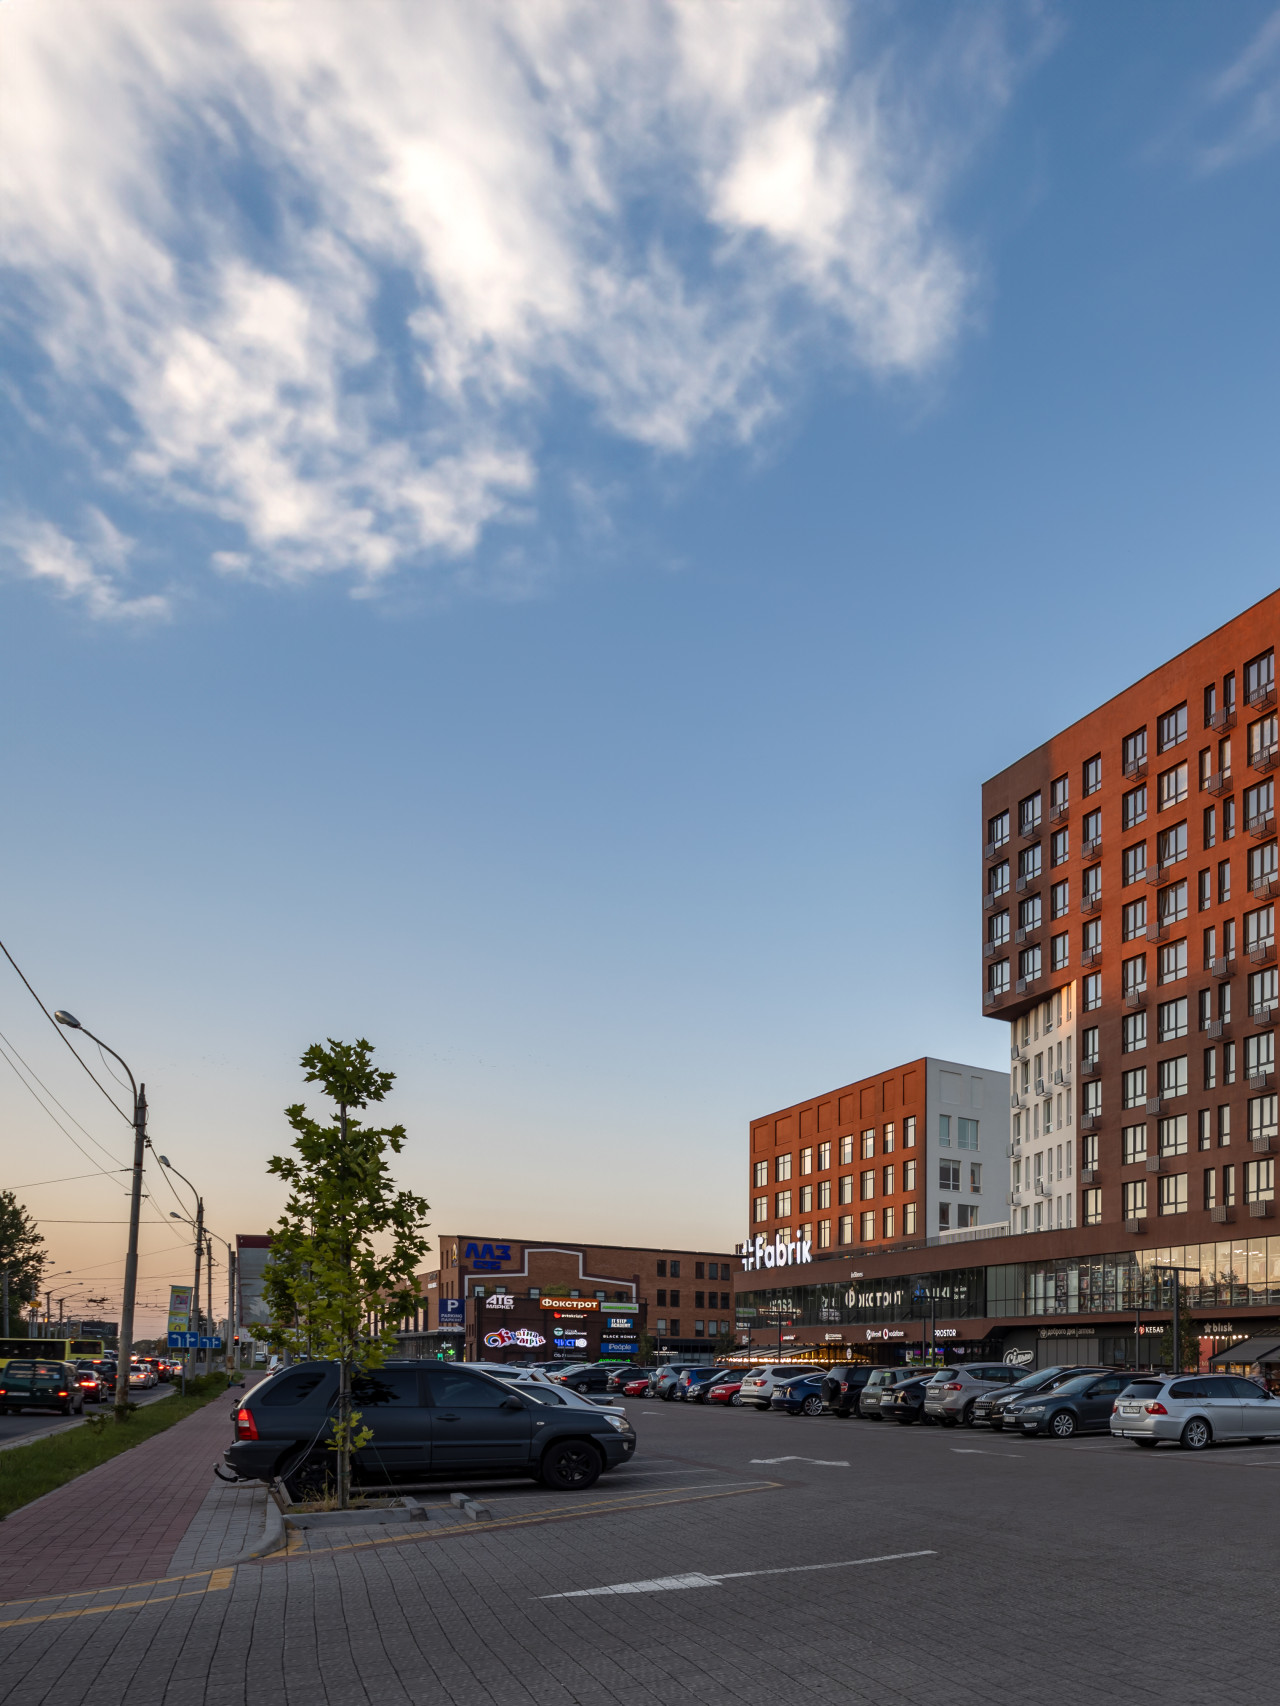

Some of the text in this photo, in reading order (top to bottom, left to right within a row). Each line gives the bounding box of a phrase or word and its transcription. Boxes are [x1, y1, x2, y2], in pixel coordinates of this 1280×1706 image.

[447, 1300, 459, 1312] P
[541, 1298, 598, 1309] Фокстрот
[1145, 1326, 1164, 1334] КЕБАБ
